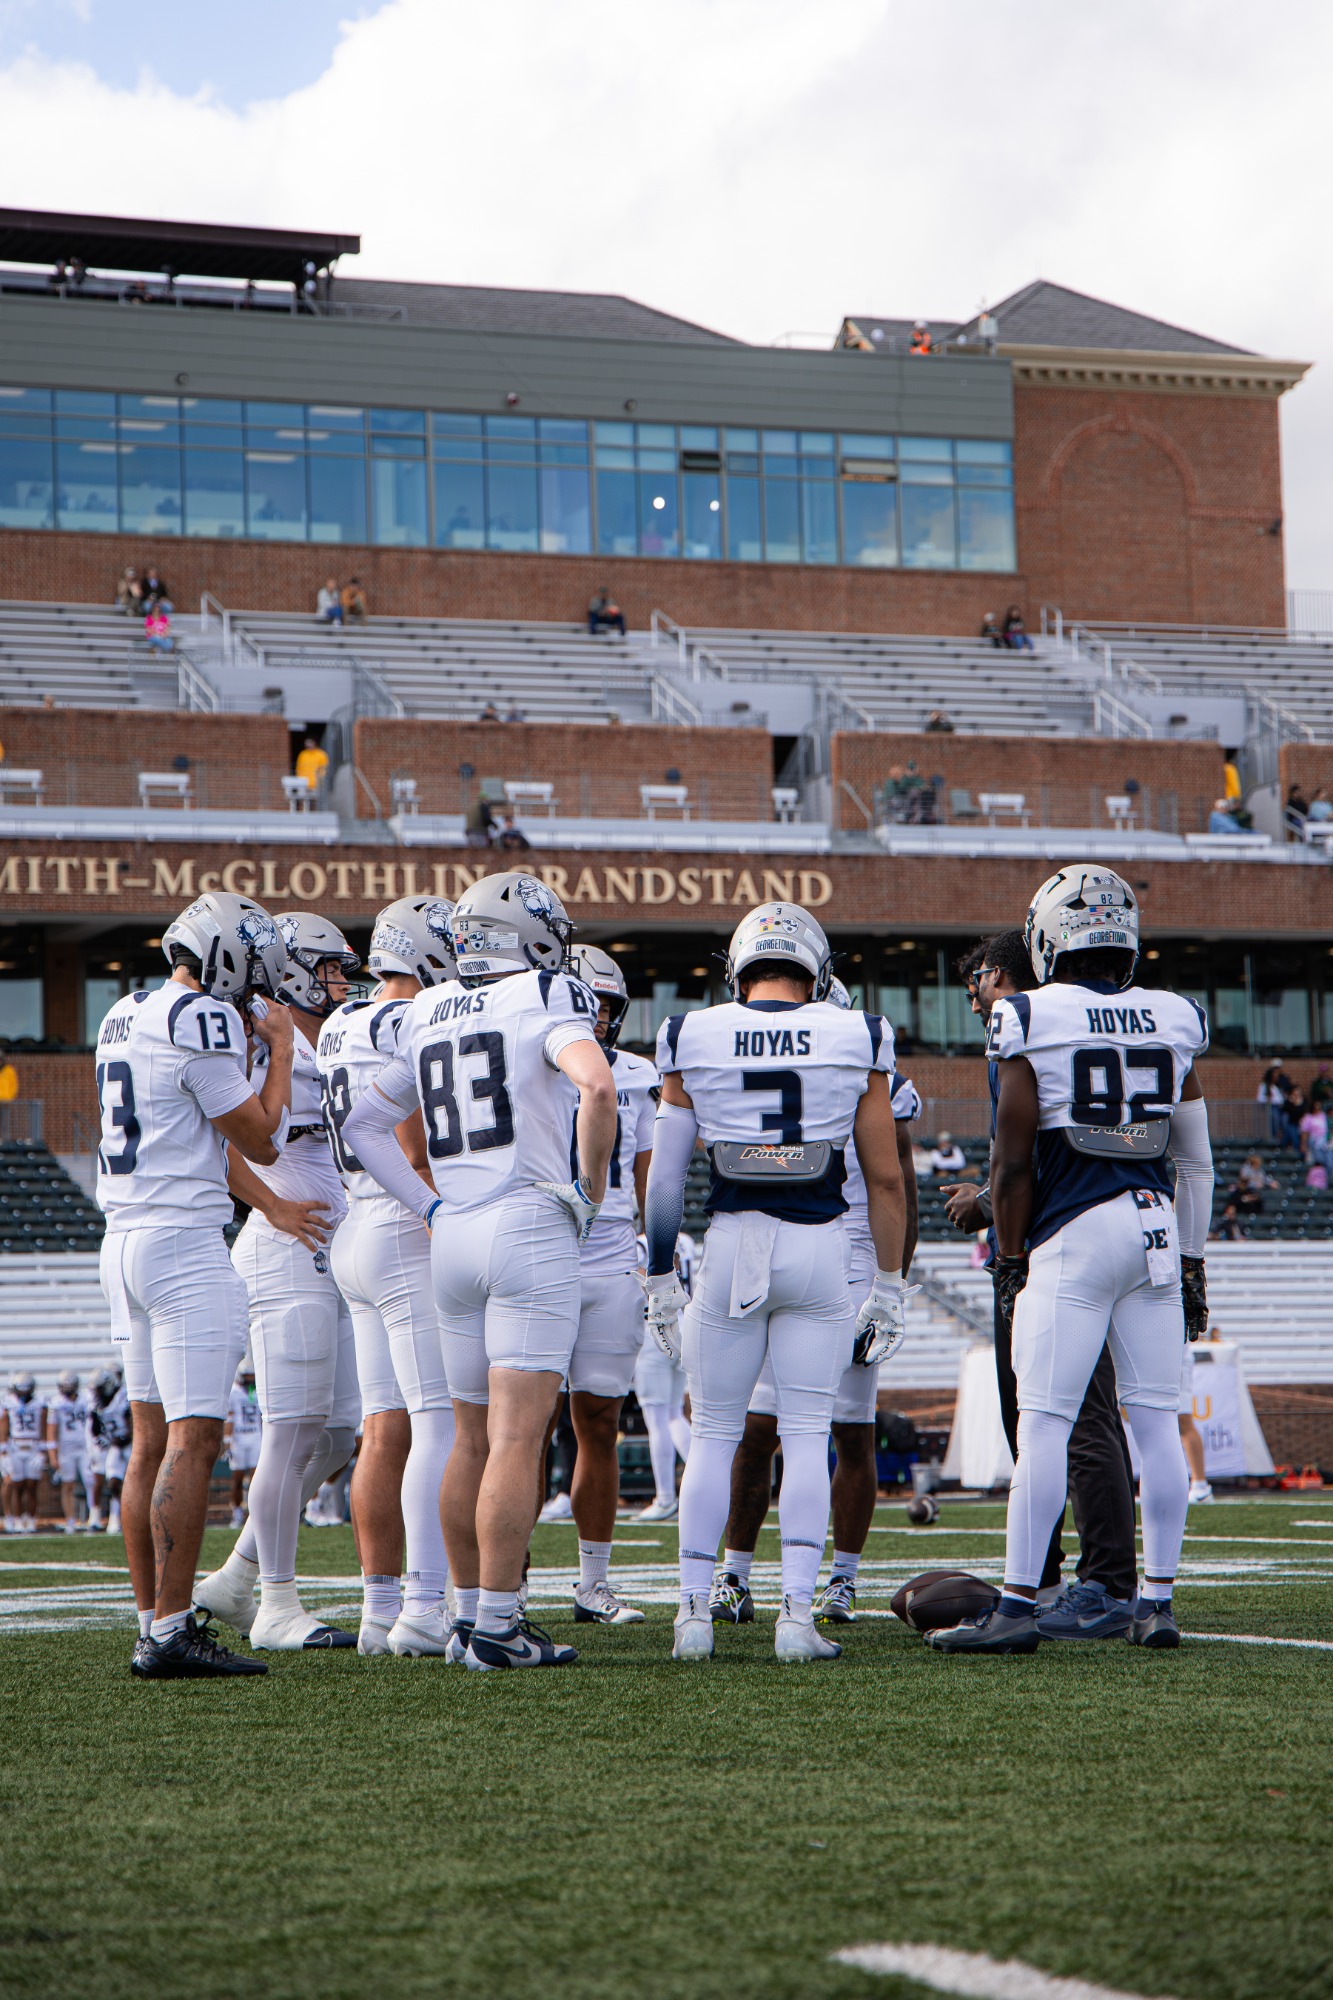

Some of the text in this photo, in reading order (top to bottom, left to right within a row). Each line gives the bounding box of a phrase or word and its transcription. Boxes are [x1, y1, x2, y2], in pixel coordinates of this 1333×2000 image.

[506, 863, 834, 907] RANDSTAND
[1101, 893, 1113, 905] 82
[776, 907, 782, 915] 3
[755, 938, 797, 953] GEORGETOWN
[1089, 930, 1128, 945] GEORGETOWN
[429, 992, 489, 1026] HOYAS
[1086, 1007, 1158, 1034] HOYAS
[100, 1015, 133, 1045] HOYAS
[196, 1011, 231, 1050] 13
[734, 1029, 811, 1057] HOYAS
[419, 1030, 516, 1161] 83
[1069, 1047, 1176, 1128] 82
[740, 1069, 804, 1145] 3
[740, 1147, 804, 1160] POWER
